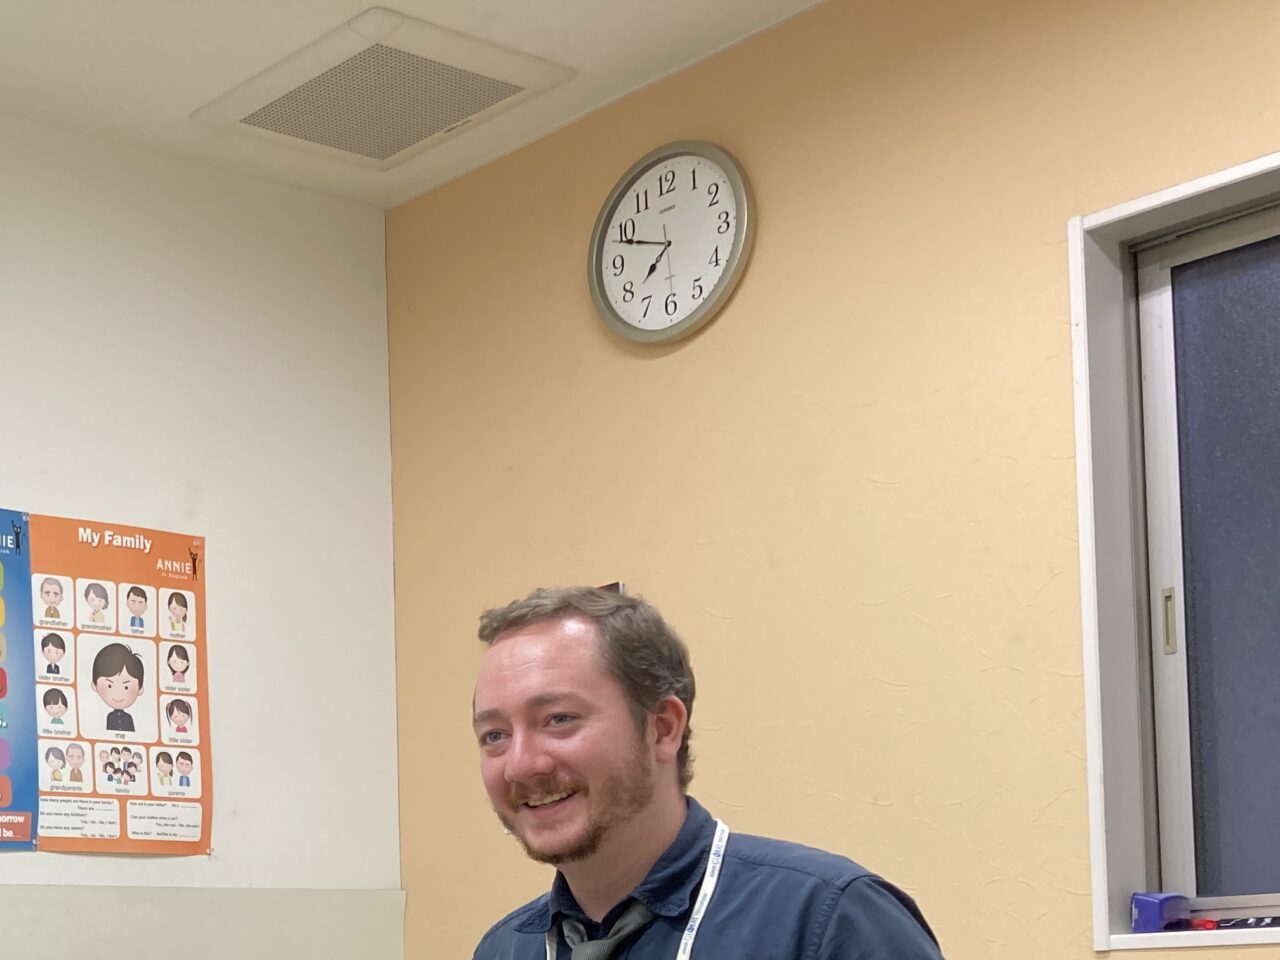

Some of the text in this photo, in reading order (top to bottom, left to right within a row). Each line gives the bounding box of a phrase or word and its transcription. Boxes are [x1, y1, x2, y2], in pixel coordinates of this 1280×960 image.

[658, 170, 675, 197] 12
[691, 168, 698, 191] 1
[635, 189, 648, 214] 11
[708, 182, 719, 207] 2
[620, 218, 635, 243] 10
[718, 211, 730, 234] 3
[613, 255, 624, 276] 9
[709, 245, 720, 268] 4
[623, 281, 634, 302] 8
[692, 277, 703, 299] 5
[641, 295, 652, 318] 7
[665, 292, 677, 316] 6
[79, 528, 152, 553] My Family
[156, 558, 191, 574] ANNIE
